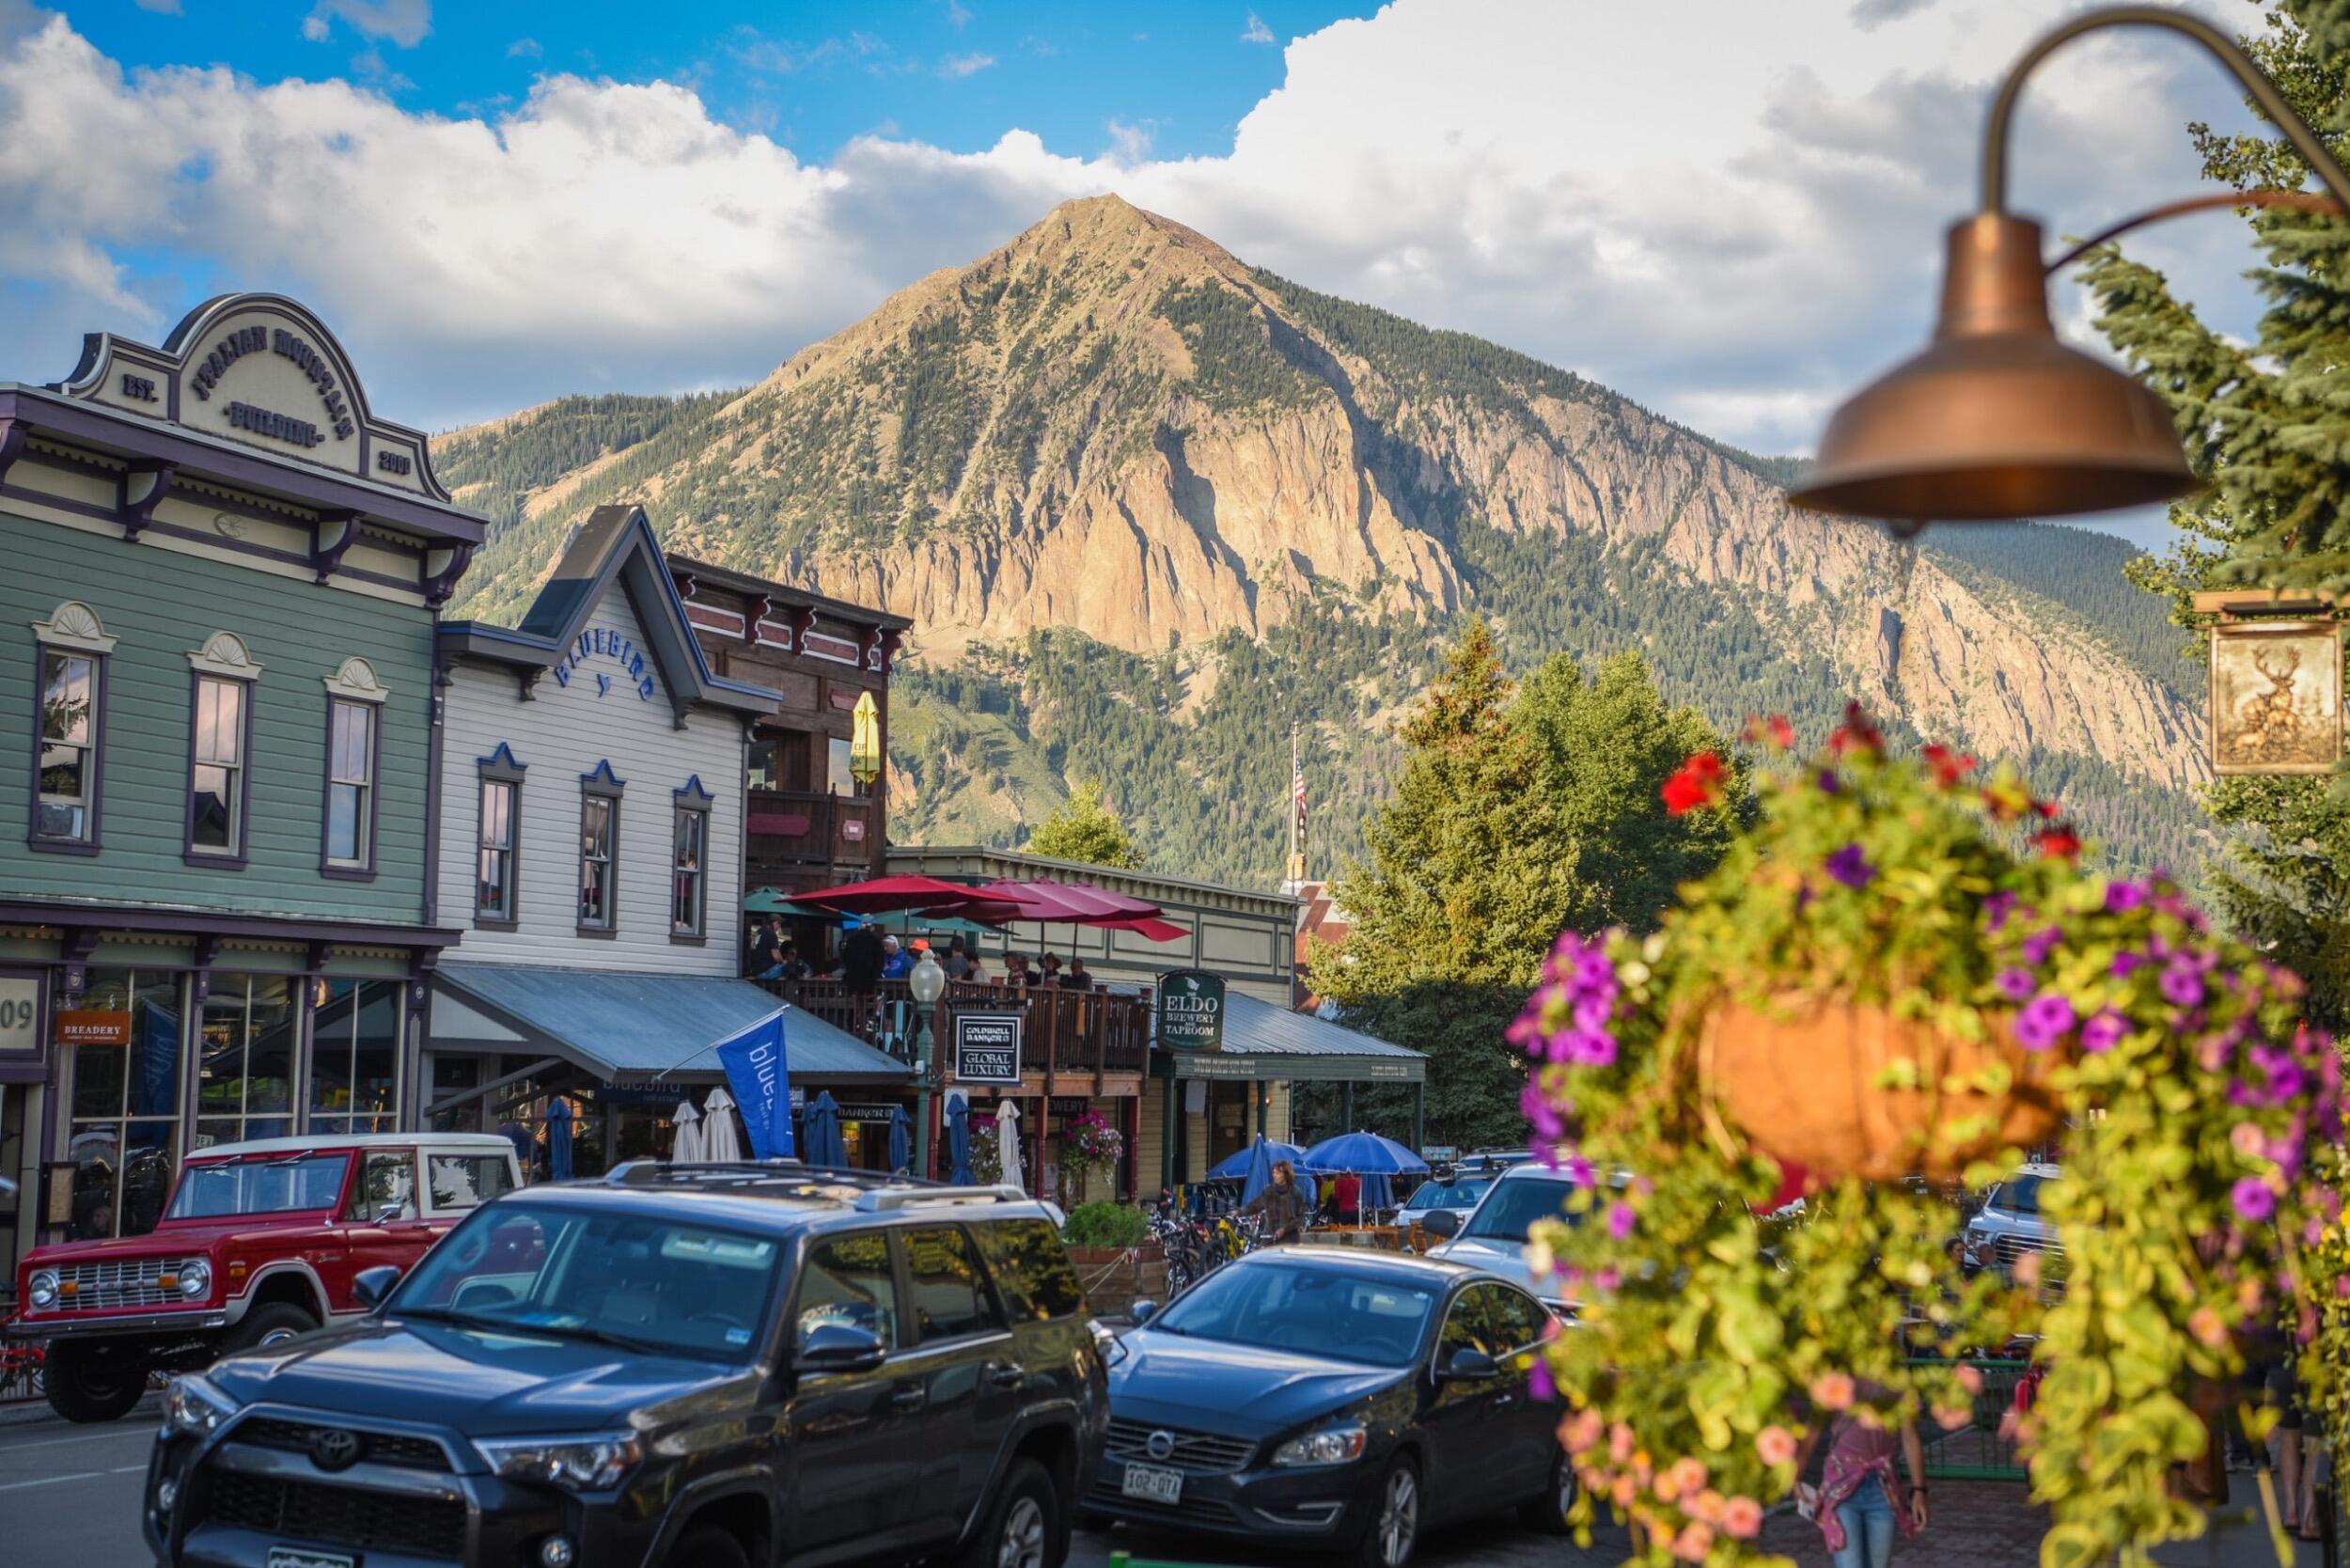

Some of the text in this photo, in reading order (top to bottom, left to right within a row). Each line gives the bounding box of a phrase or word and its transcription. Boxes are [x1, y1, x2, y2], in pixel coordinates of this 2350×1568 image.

[123, 373, 159, 402] EST.
[191, 325, 355, 441] ITALIAN MOUNTAIN
[230, 401, 317, 447] BUILDING
[555, 628, 654, 701] BLUEBIRD
[1166, 996, 1218, 1012] ELDO
[1167, 1012, 1215, 1023] BREWERY
[64, 1026, 121, 1035] BREADERY
[965, 1027, 1010, 1035] COLDWELL
[1165, 1025, 1215, 1036] TAPROOM
[965, 1034, 1002, 1043] BANKER
[965, 1053, 1010, 1064] GLOBAL
[964, 1064, 1011, 1075] LUXURY
